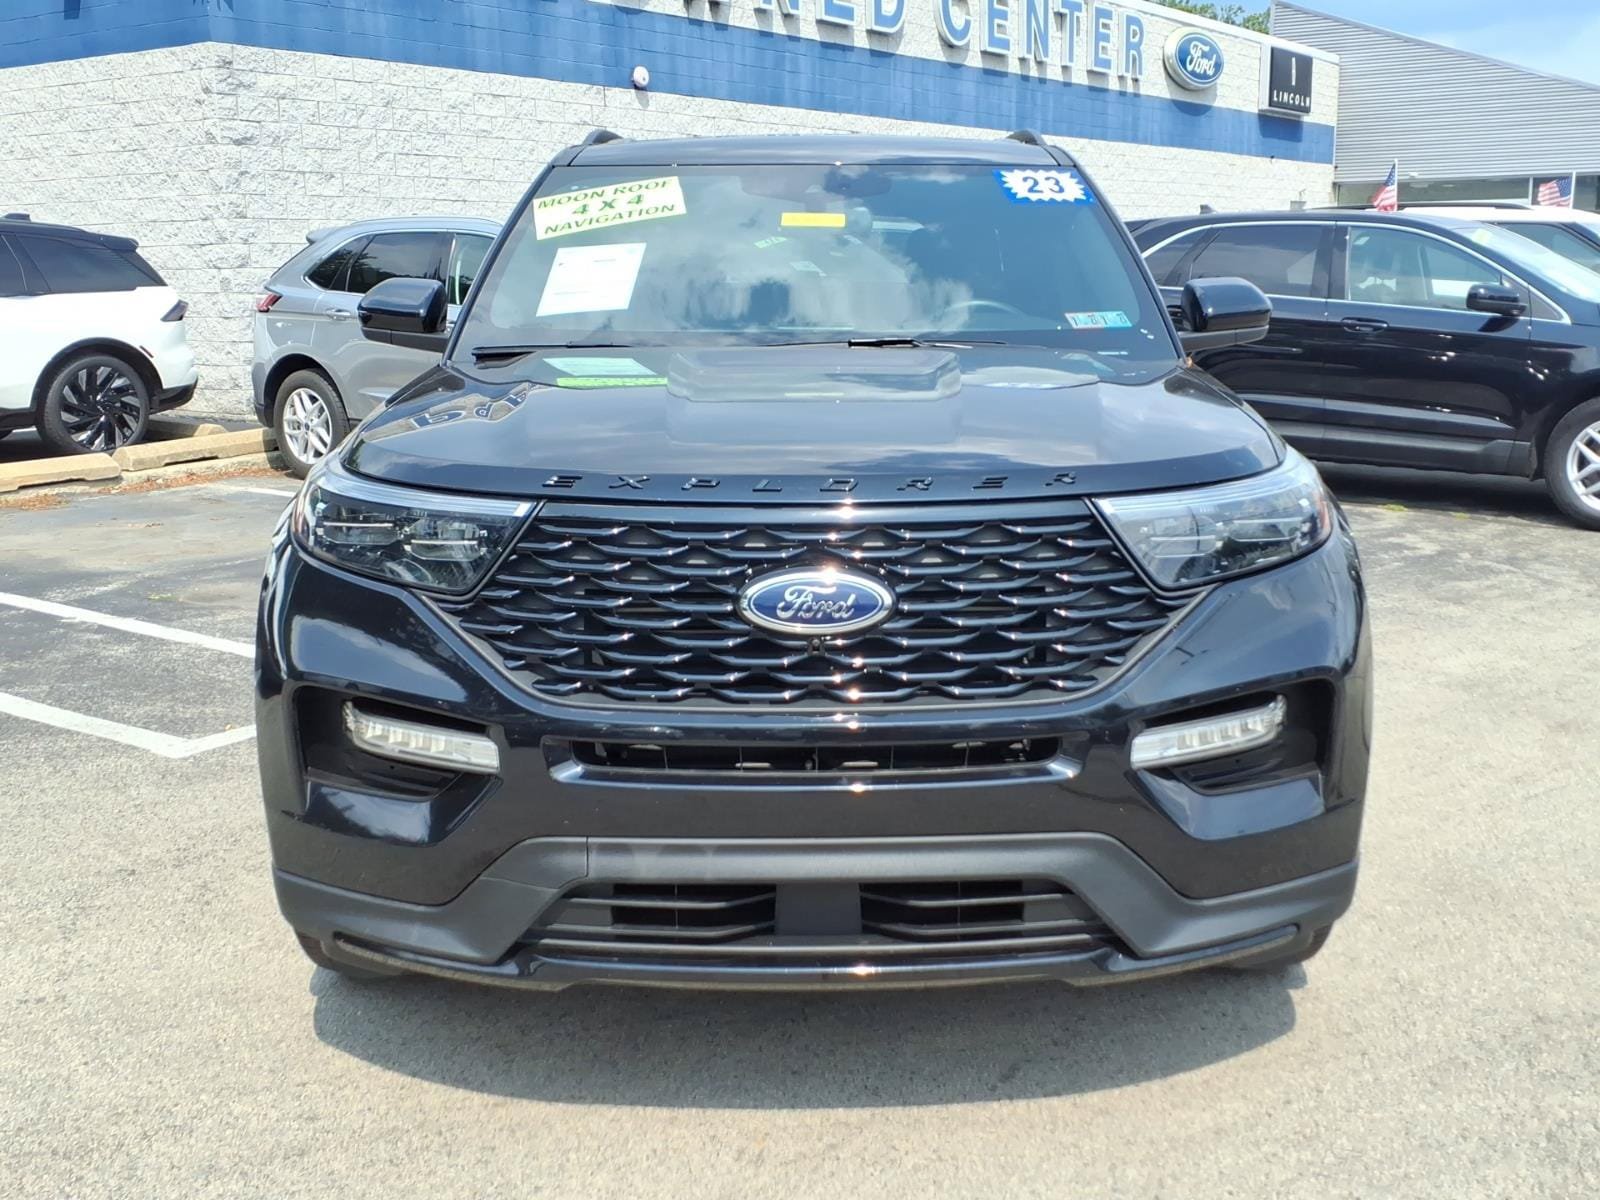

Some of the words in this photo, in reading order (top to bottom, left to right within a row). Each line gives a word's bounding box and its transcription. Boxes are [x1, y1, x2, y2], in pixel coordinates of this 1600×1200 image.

[938, 0, 1145, 79] CENTER
[1185, 41, 1217, 76] Ford
[1273, 90, 1311, 107] LINCOLN
[538, 190, 606, 209] MOON
[611, 178, 673, 196] ROOF
[1022, 176, 1065, 194] 23
[543, 203, 676, 235] NAVIGATION
[542, 470, 1077, 493] EXPLORER
[776, 585, 856, 619] Ford
